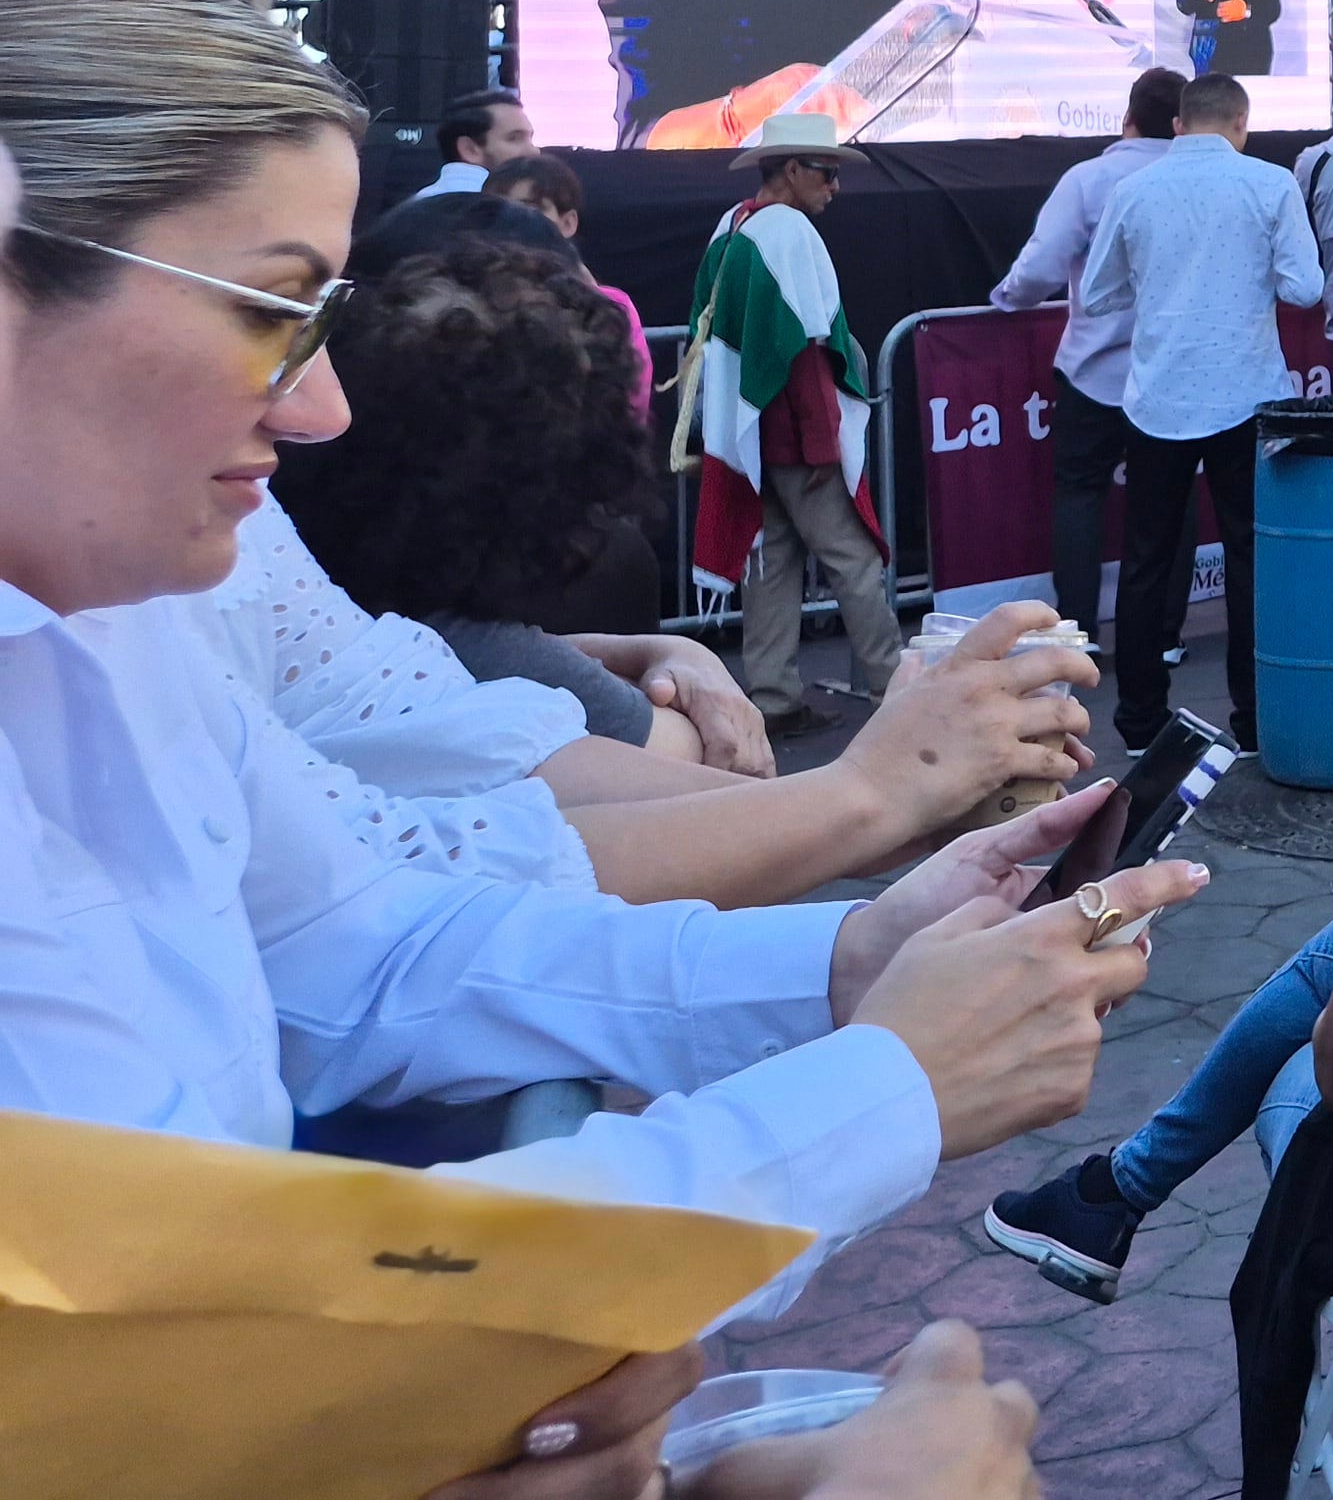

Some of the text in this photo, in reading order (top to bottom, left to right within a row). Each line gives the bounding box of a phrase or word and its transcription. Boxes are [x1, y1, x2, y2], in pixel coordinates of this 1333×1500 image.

[1057, 100, 1122, 133] Gobier
[929, 397, 1000, 453] La
[1195, 556, 1224, 569] Gobi
